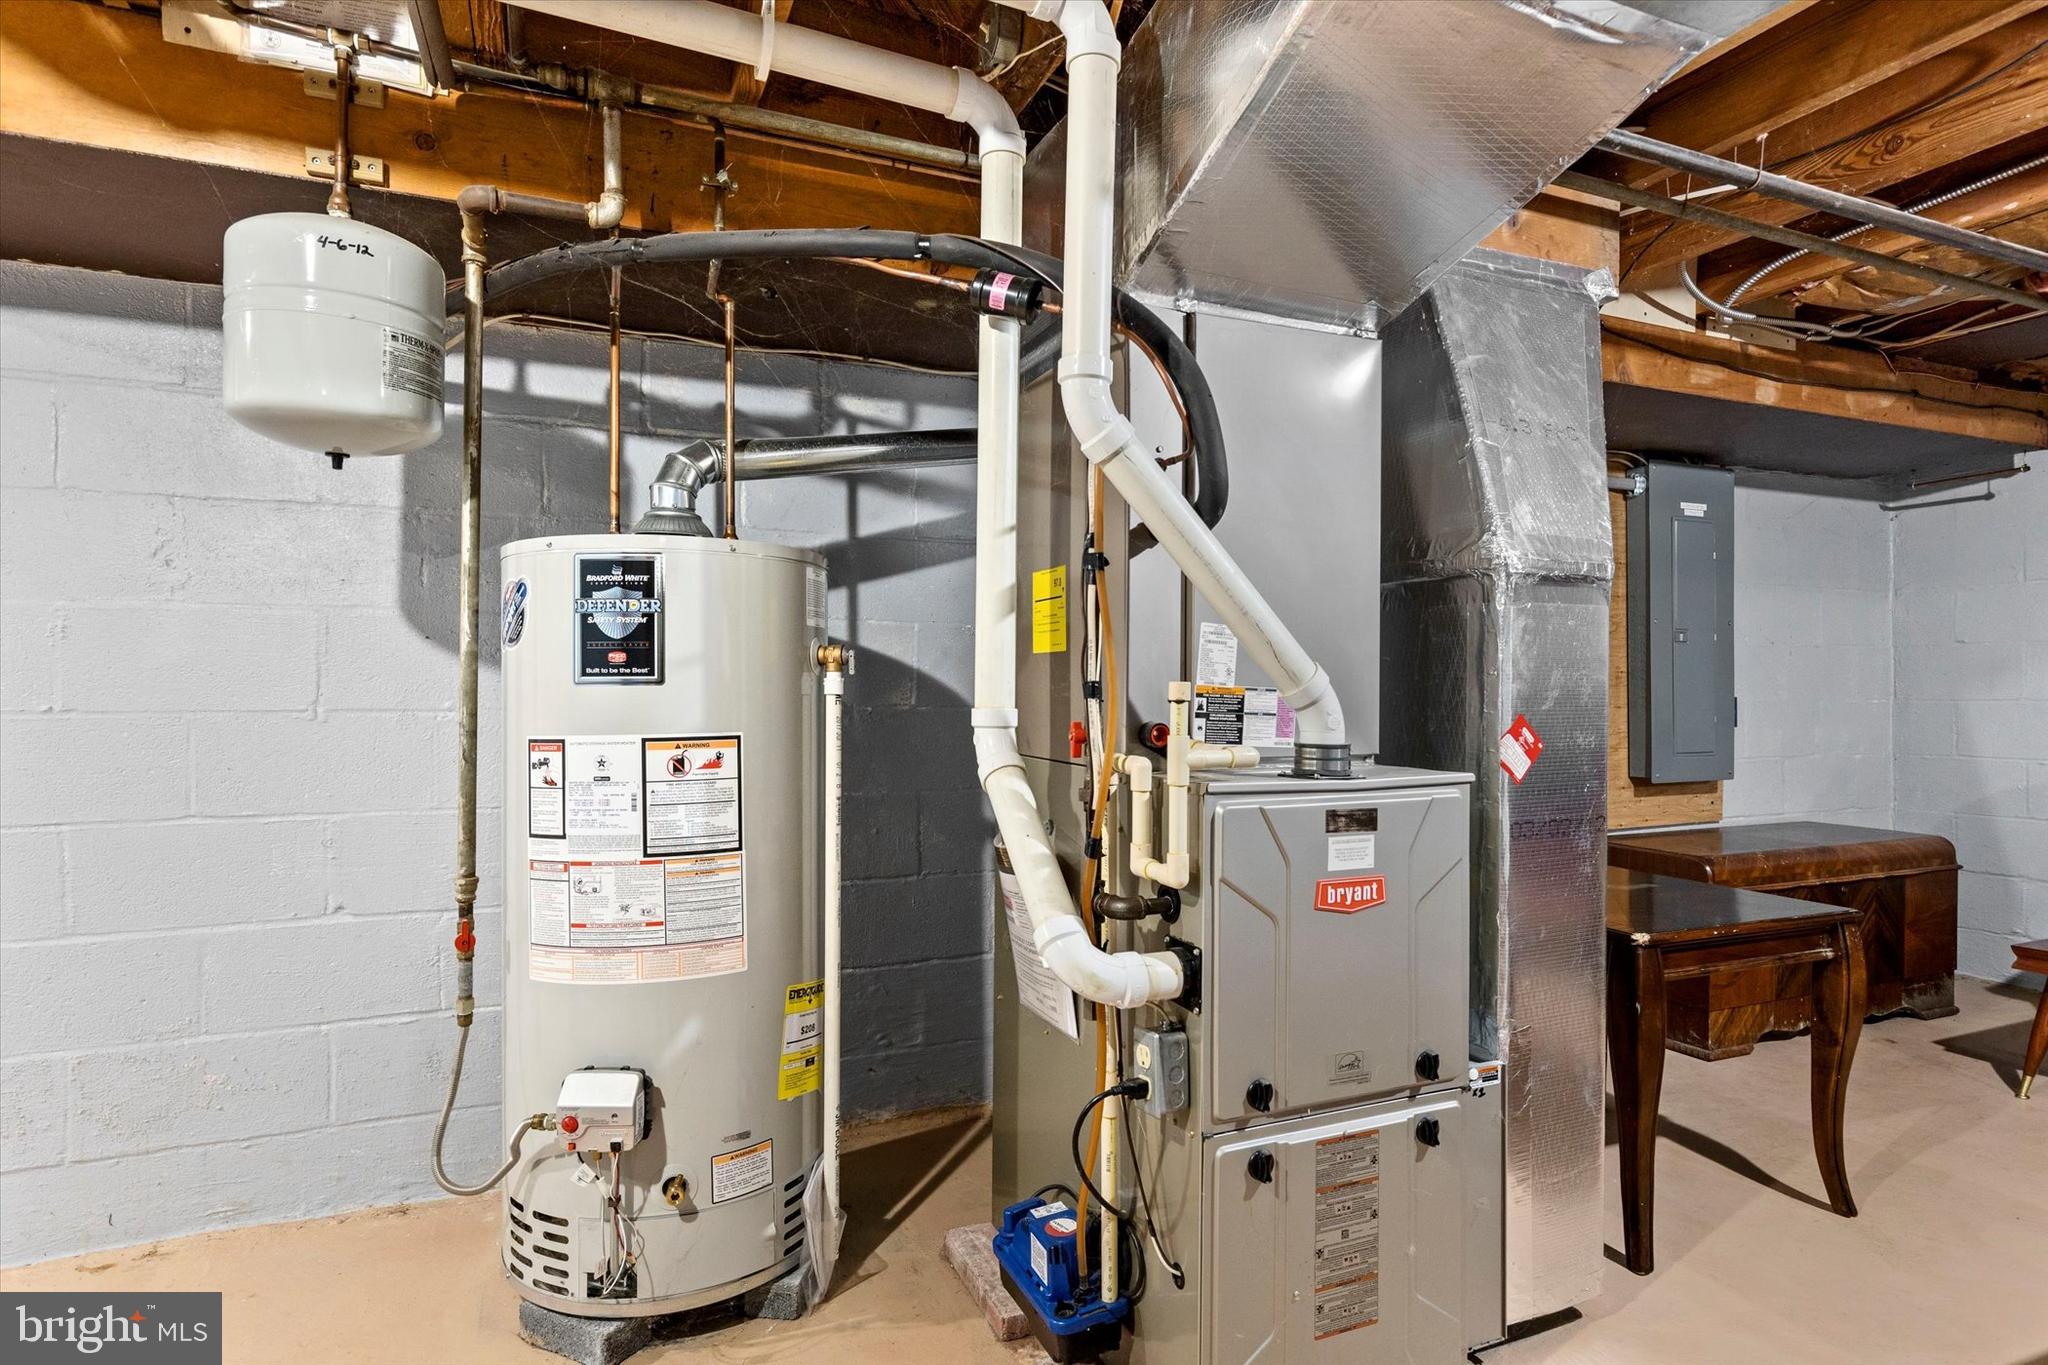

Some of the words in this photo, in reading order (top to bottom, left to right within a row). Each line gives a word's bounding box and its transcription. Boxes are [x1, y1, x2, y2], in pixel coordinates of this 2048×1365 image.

[317, 235, 374, 257] 4-6-12
[576, 598, 662, 613] DEFENDER
[616, 616, 647, 624] SYSTEM
[1328, 882, 1378, 905] bryant
